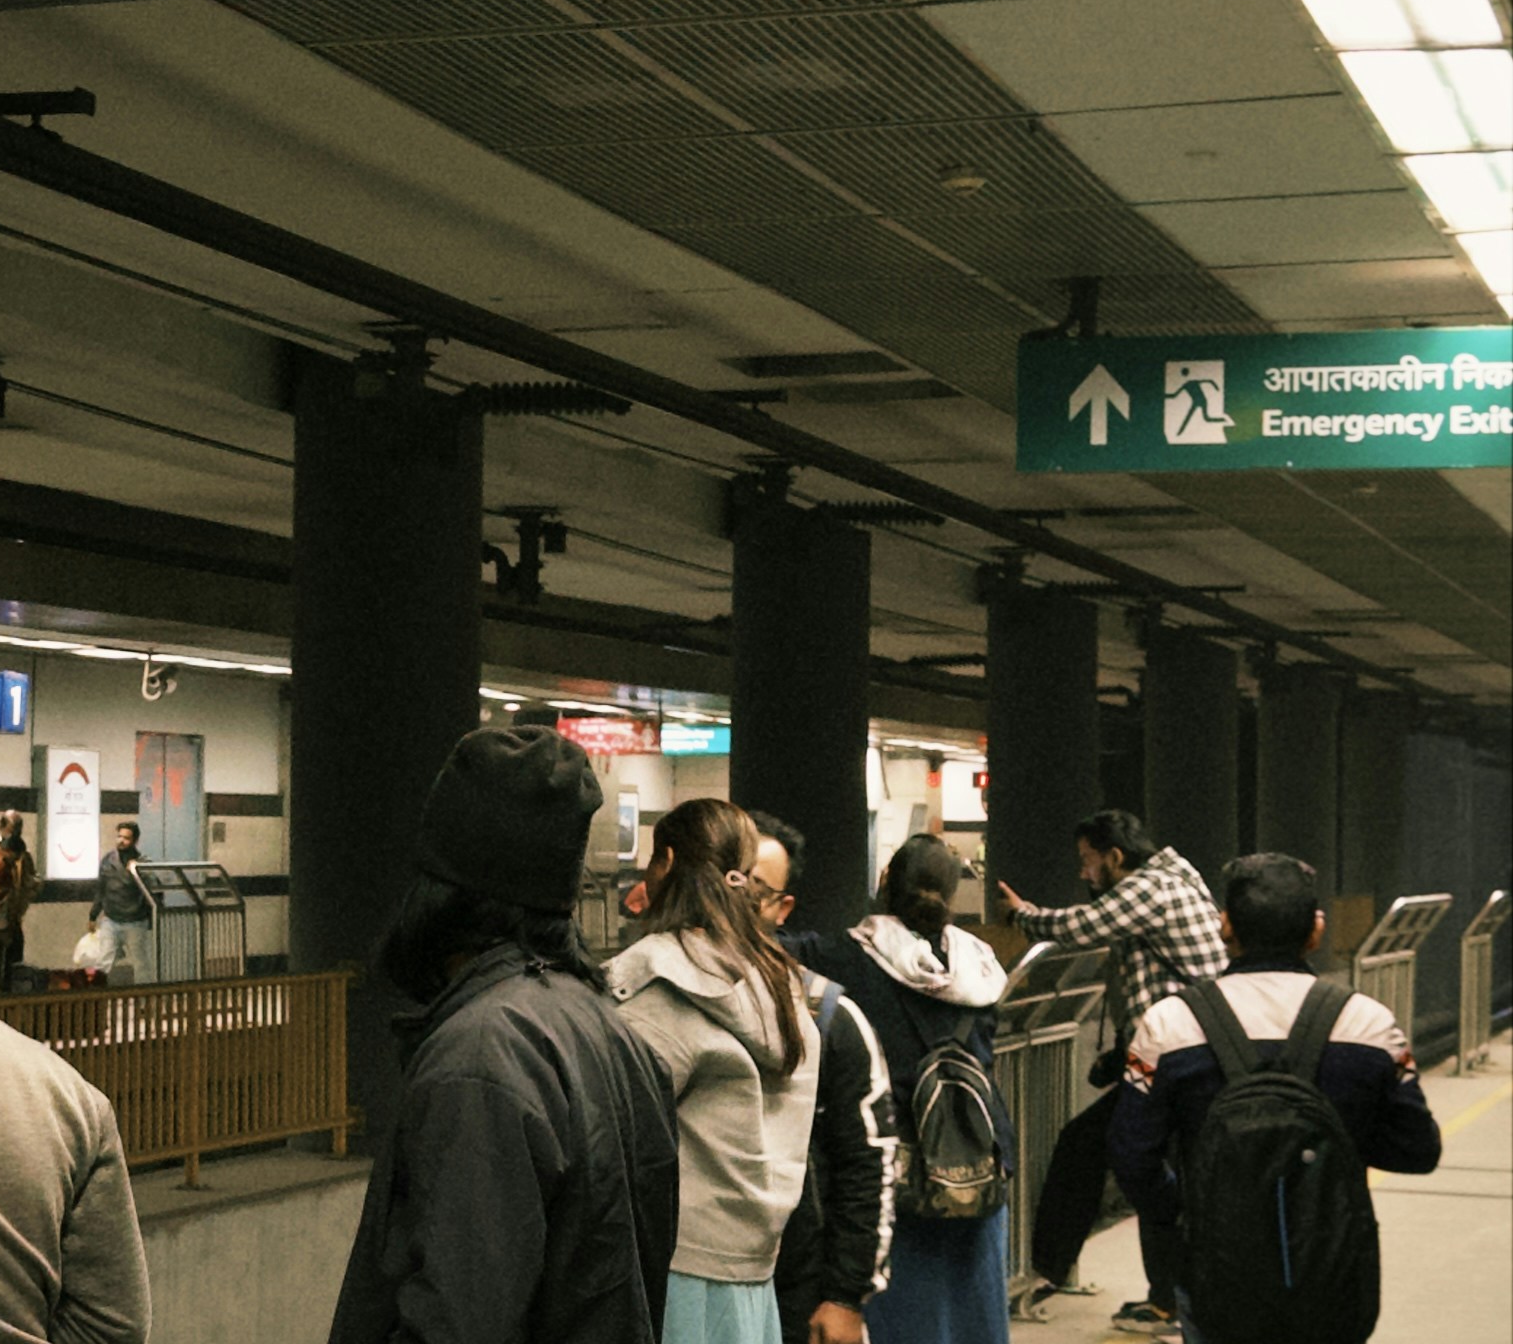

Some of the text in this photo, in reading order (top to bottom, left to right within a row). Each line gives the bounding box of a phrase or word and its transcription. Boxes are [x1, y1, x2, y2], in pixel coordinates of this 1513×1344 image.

[1264, 354, 1448, 392] आपातकालीन
[1262, 404, 1512, 442] Emergency Exit
[10, 685, 22, 726] 1
